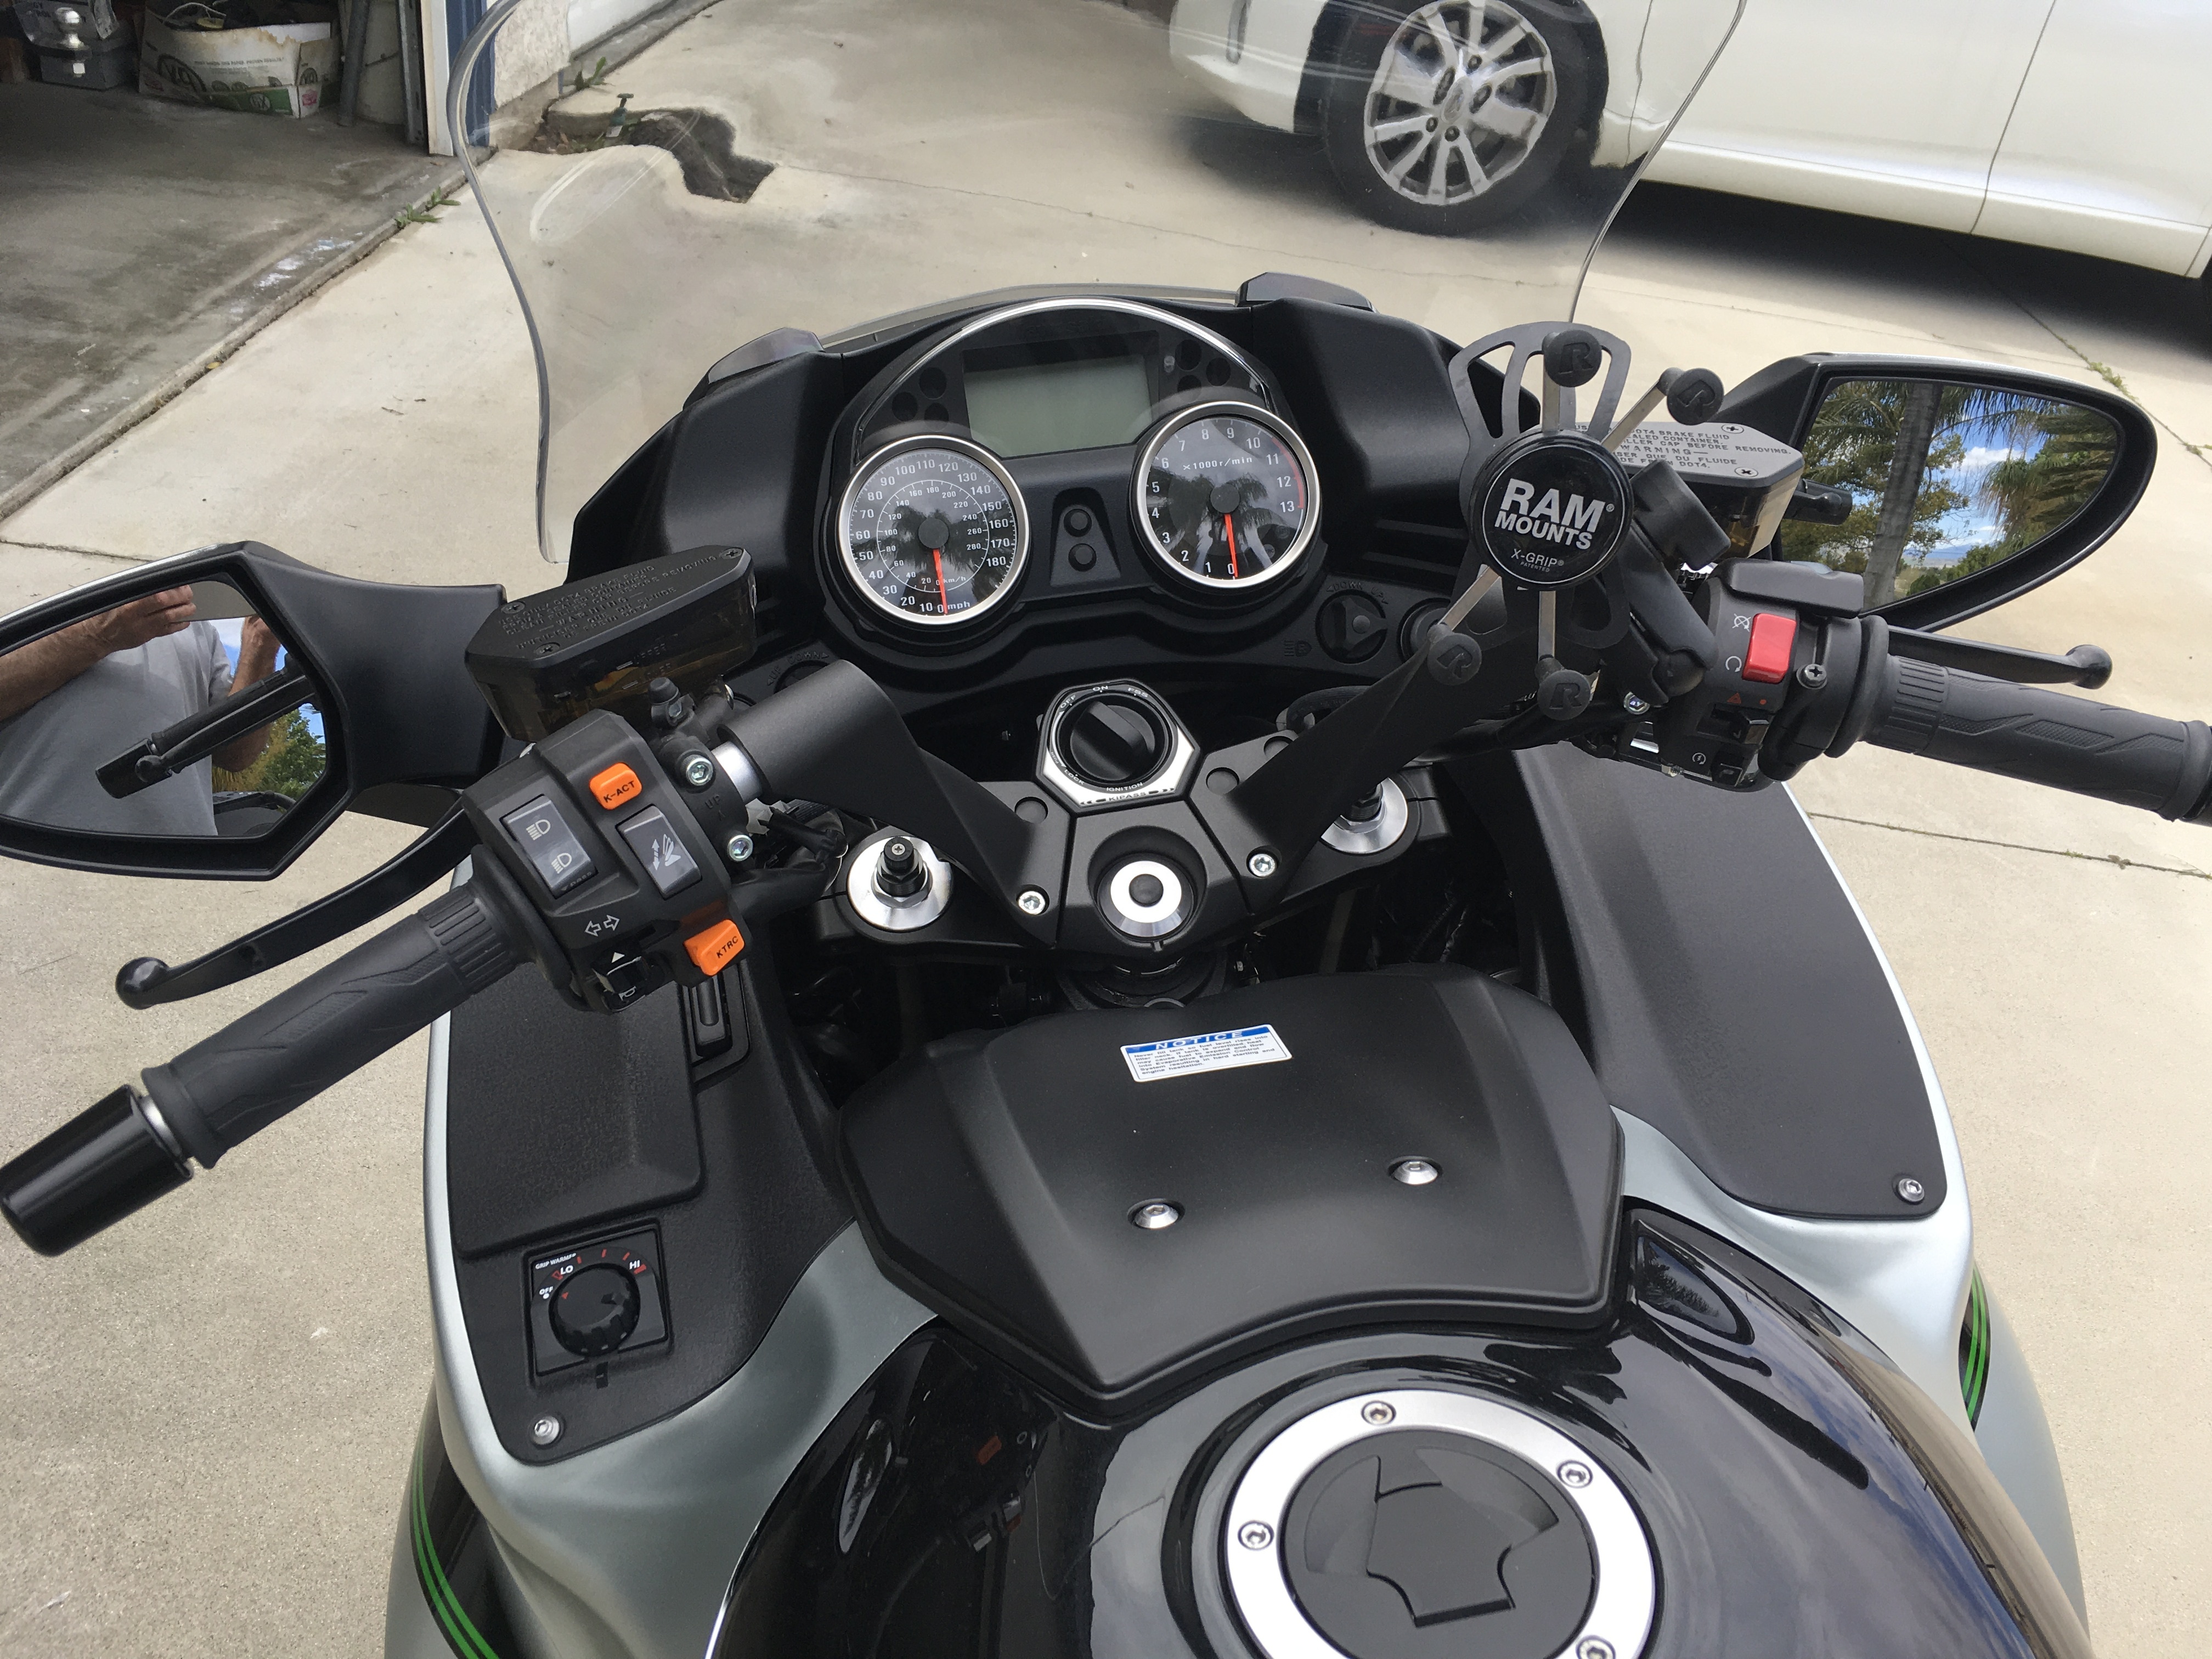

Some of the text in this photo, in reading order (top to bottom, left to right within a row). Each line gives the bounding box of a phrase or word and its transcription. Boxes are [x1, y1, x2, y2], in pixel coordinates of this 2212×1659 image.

[1202, 429, 1209, 439] 8
[1227, 427, 1234, 438] 9
[1179, 441, 1186, 451] 7
[1246, 437, 1260, 449] 10
[1162, 458, 1169, 468] 6
[1266, 454, 1279, 465] 11
[895, 465, 916, 475] 100
[917, 460, 935, 470] 110
[939, 462, 958, 472] 120
[880, 476, 895, 486] 90
[957, 472, 977, 482] 130
[1277, 476, 1291, 487] 12
[970, 485, 991, 495] 140
[1152, 482, 1160, 493] 5
[867, 491, 883, 501] 80
[983, 501, 1002, 511] 150
[1280, 501, 1294, 512] 13
[860, 509, 874, 519] 70
[1152, 507, 1159, 518] 4
[989, 518, 1008, 529] 160
[856, 530, 870, 540] 60
[1494, 510, 1592, 550] MOUNTS
[1163, 532, 1170, 543] 3
[991, 538, 1010, 548] 170
[859, 551, 873, 560] 50
[1181, 550, 1189, 561] 2
[986, 556, 1006, 567] 180
[1206, 562, 1211, 573] 1
[1228, 564, 1234, 574] 0
[869, 570, 884, 579] 40
[883, 585, 897, 595] 30
[901, 596, 915, 606] 20
[947, 601, 970, 611] mph
[920, 603, 933, 612] 10
[1060, 695, 1076, 709] OFF
[1064, 769, 1085, 785] LOCK
[603, 781, 636, 803] K-ACT
[1107, 782, 1143, 792] IGNITION
[716, 935, 739, 959] KTRC
[1155, 1031, 1243, 1049] NOTICE
[535, 1261, 550, 1269] GRIP
[561, 1265, 573, 1274] LO
[629, 1260, 640, 1269] HI
[539, 1286, 553, 1295] OFF
